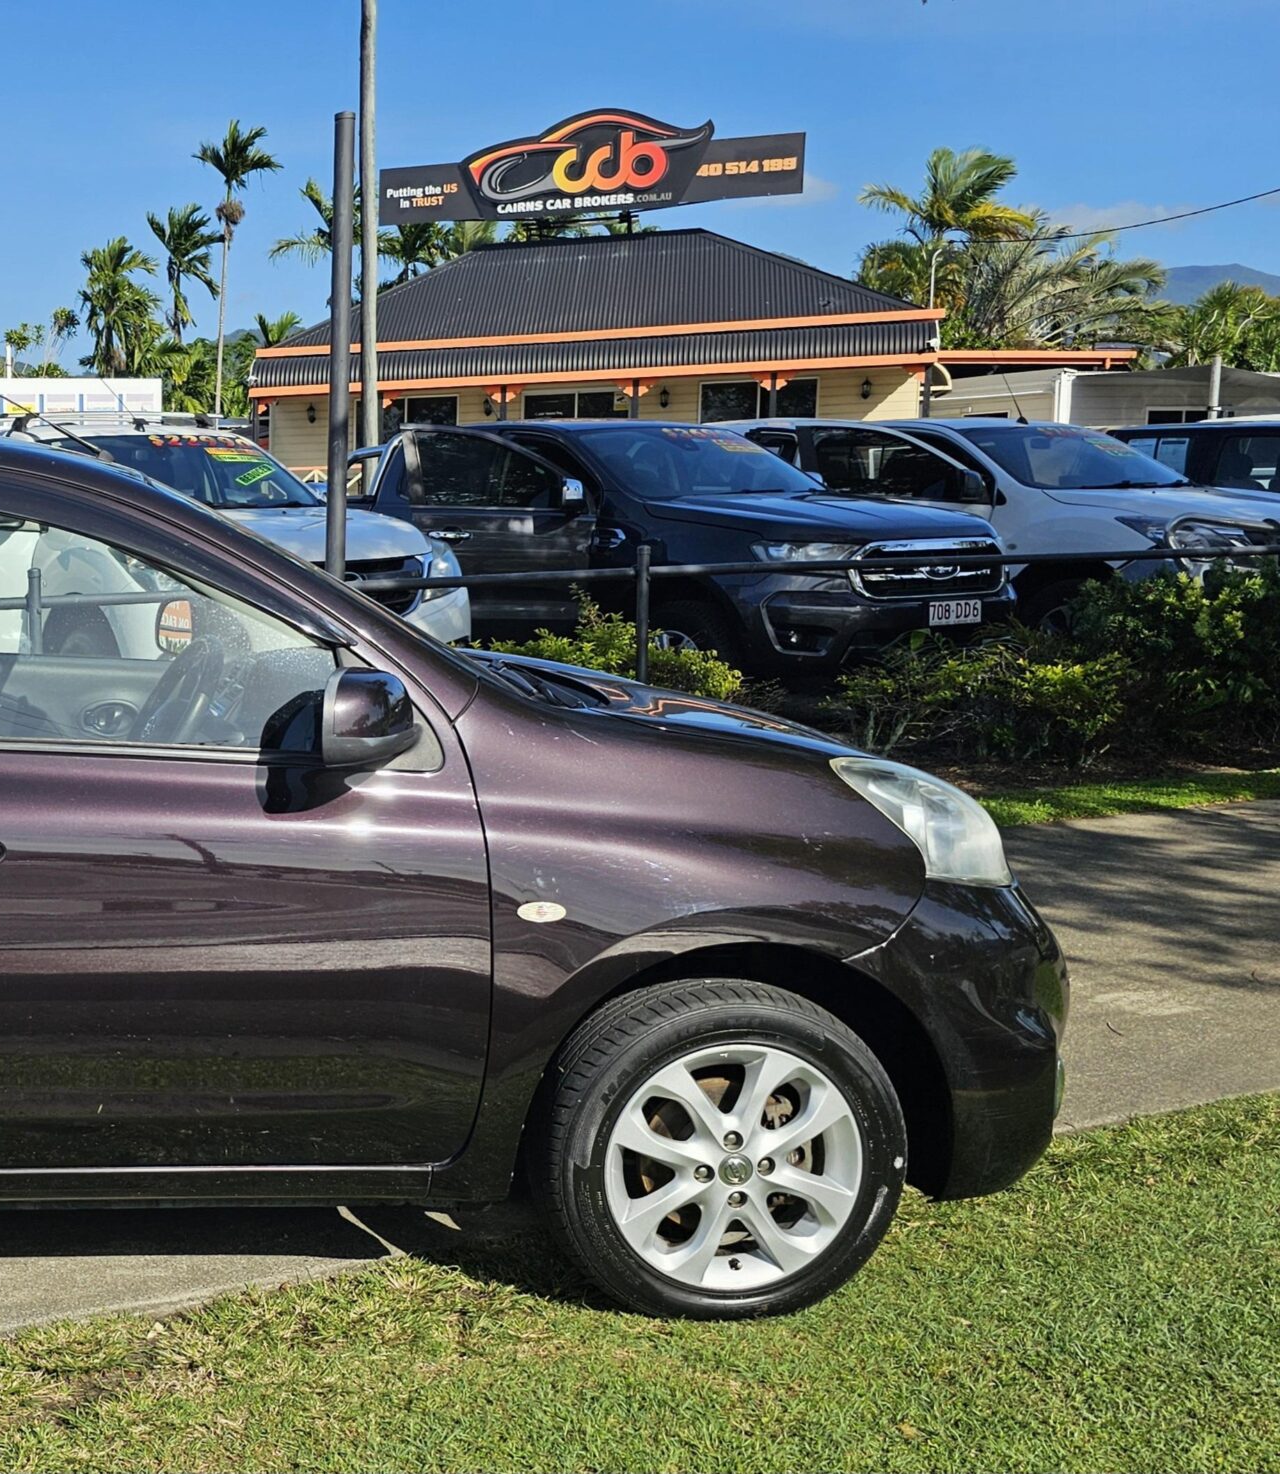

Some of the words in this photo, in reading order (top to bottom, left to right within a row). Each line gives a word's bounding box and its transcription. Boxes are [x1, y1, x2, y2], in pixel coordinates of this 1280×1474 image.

[696, 163, 722, 177] 40
[725, 159, 761, 175] 514
[762, 157, 798, 172] 199
[387, 186, 423, 199] Putting
[425, 185, 441, 196] the
[443, 183, 458, 194] US
[400, 197, 410, 209] in
[411, 196, 445, 207] TRUST
[497, 200, 543, 215] CAIRNS
[545, 197, 572, 211] CAR
